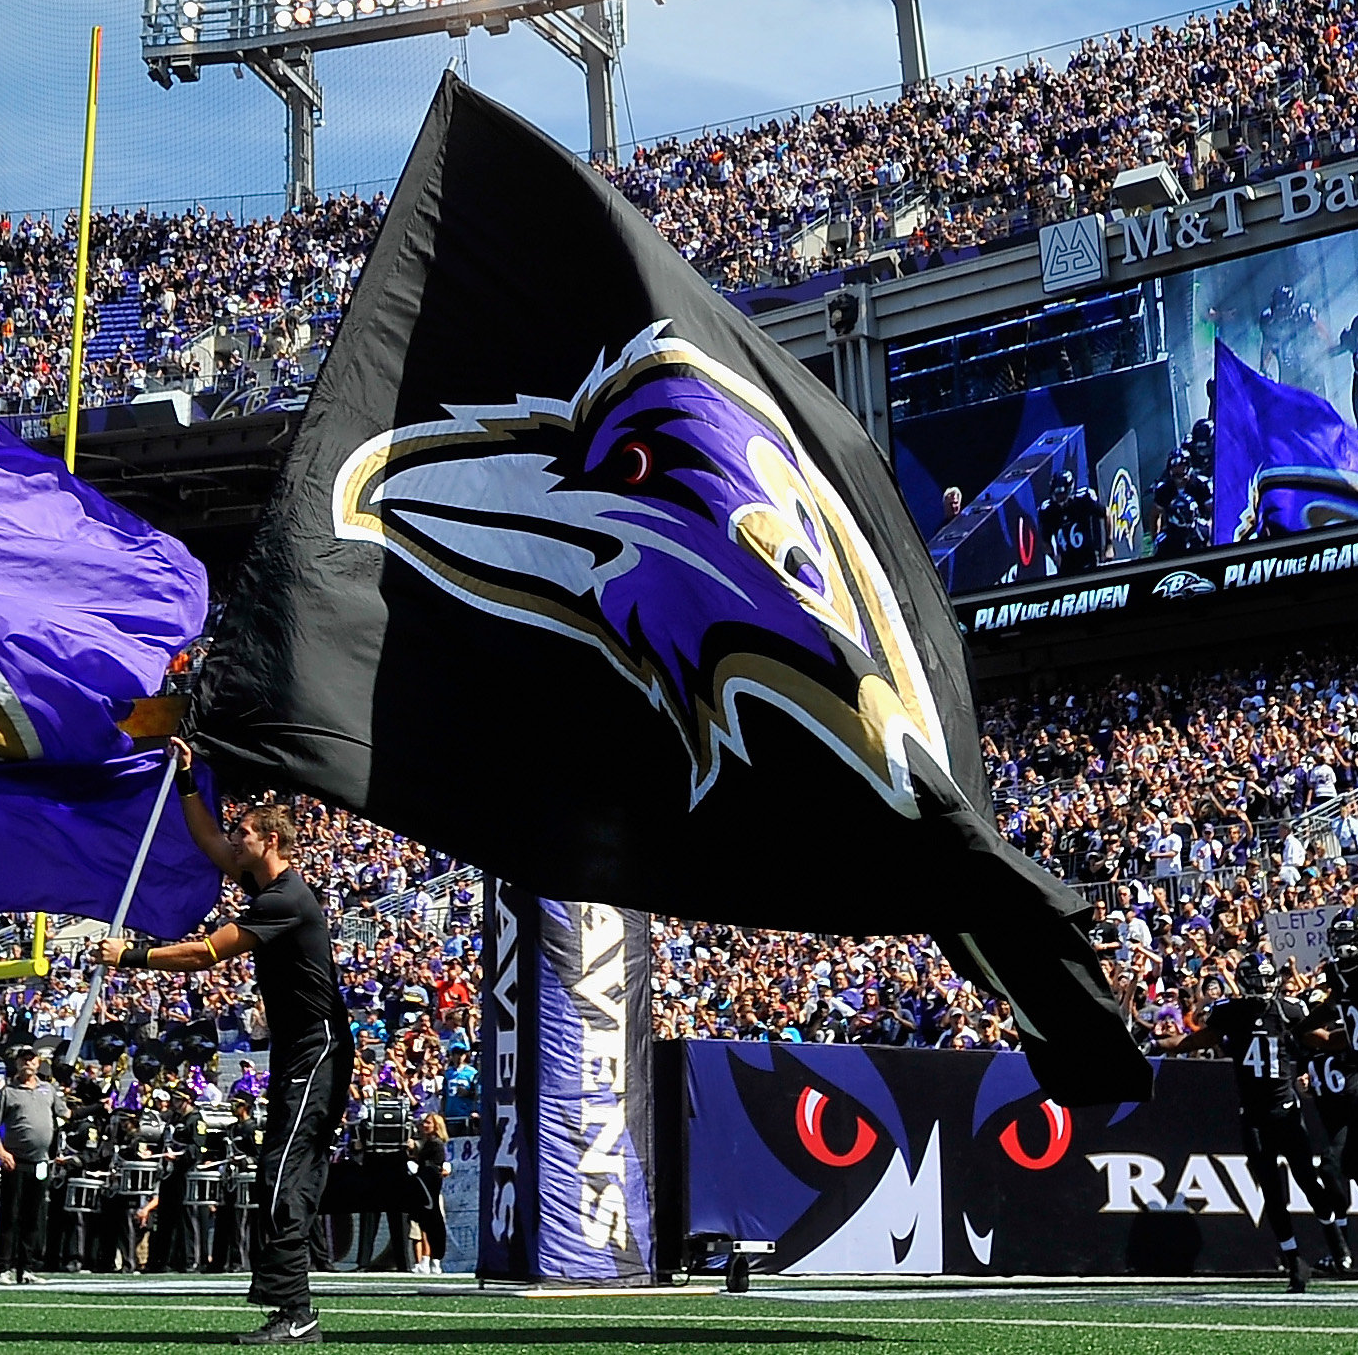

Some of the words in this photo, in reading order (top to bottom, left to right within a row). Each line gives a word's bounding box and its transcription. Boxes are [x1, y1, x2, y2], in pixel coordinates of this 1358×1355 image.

[1120, 185, 1256, 265] M&T
[1223, 557, 1279, 591] PLAY
[1275, 556, 1307, 579] LIKE
[1309, 556, 1322, 574] A
[974, 600, 1024, 633] PLAY
[1020, 601, 1050, 623] LIKE
[1050, 600, 1061, 619] A
[1060, 584, 1131, 619] RAVEN
[1273, 932, 1296, 952] GO
[1275, 908, 1327, 931] LET'S
[490, 878, 519, 1243] AVENS
[573, 901, 628, 1252] AVENS
[1243, 1036, 1280, 1079] 41
